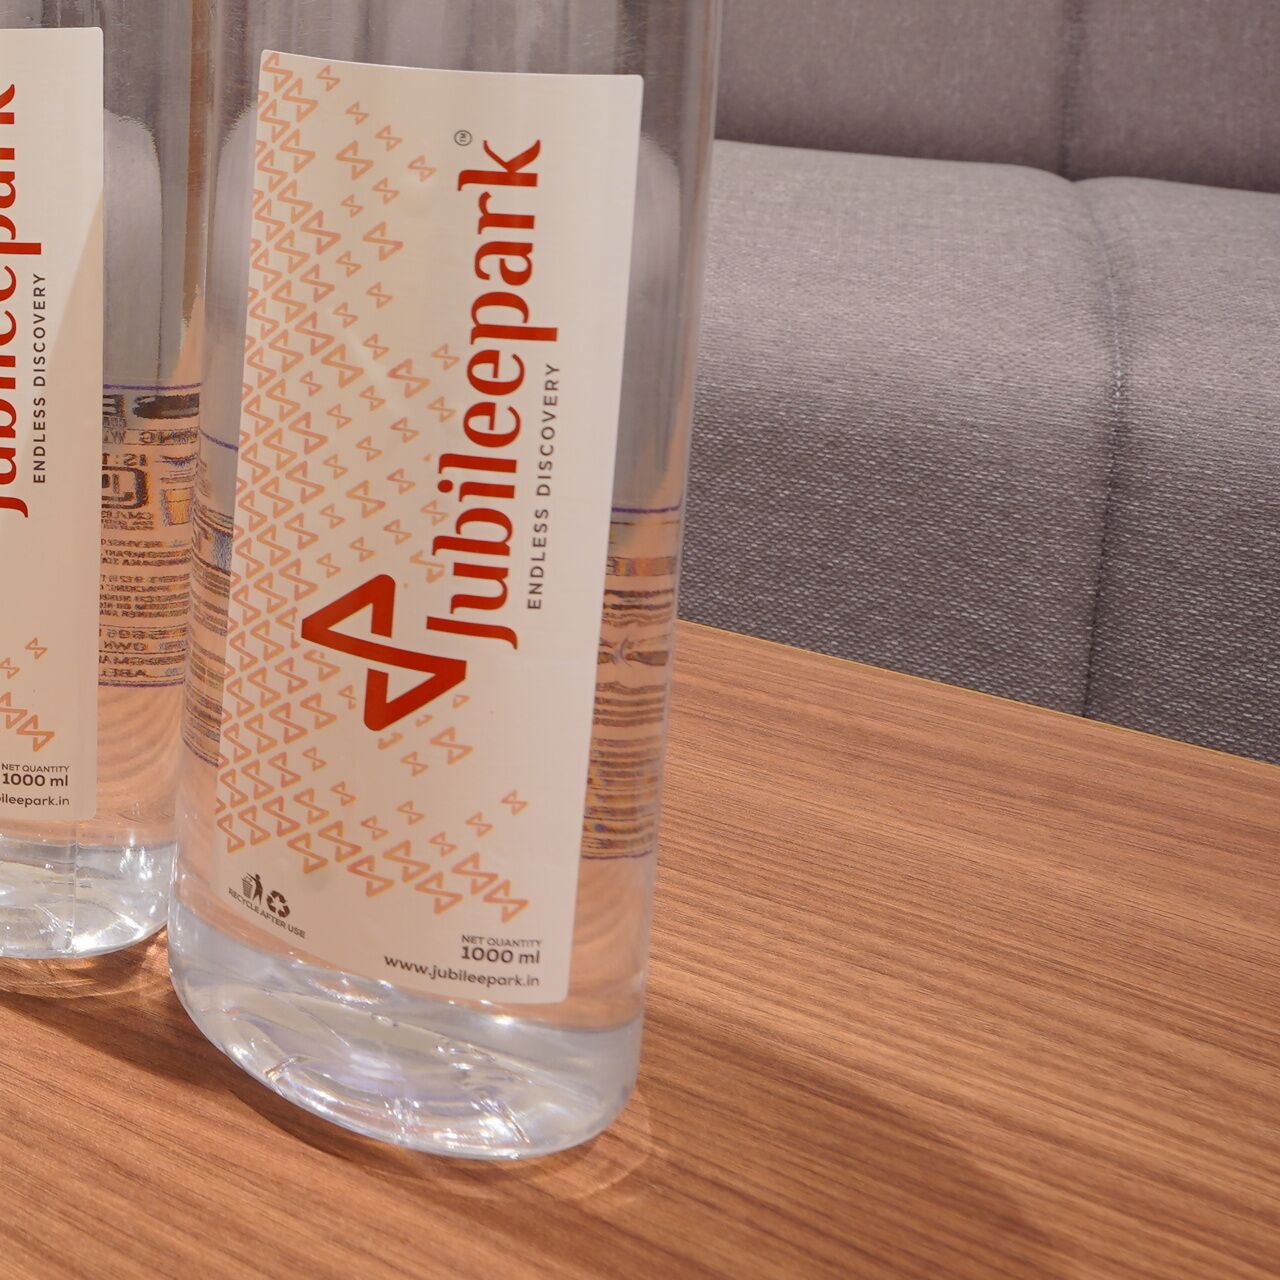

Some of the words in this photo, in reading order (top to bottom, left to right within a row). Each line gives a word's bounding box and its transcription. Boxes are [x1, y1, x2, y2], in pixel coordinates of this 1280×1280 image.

[33, 273, 47, 387] DISCOVERY
[426, 139, 559, 650] Jubileepark
[32, 397, 46, 483] ENDLESS
[536, 363, 561, 496] DISCOVERY
[527, 508, 549, 610] ENDLESS
[1, 763, 20, 771] NET
[22, 765, 69, 773] QUANTITY
[2, 773, 45, 786] 1000
[50, 774, 68, 786] ml
[228, 887, 260, 914] RECYCLE
[260, 910, 287, 930] AFTER
[287, 924, 306, 939] USE
[461, 934, 485, 945] NET
[487, 937, 542, 948] QUANTITY
[461, 946, 514, 964] 1000
[519, 950, 540, 964] ml
[383, 955, 541, 987] www.jubileepark.in
